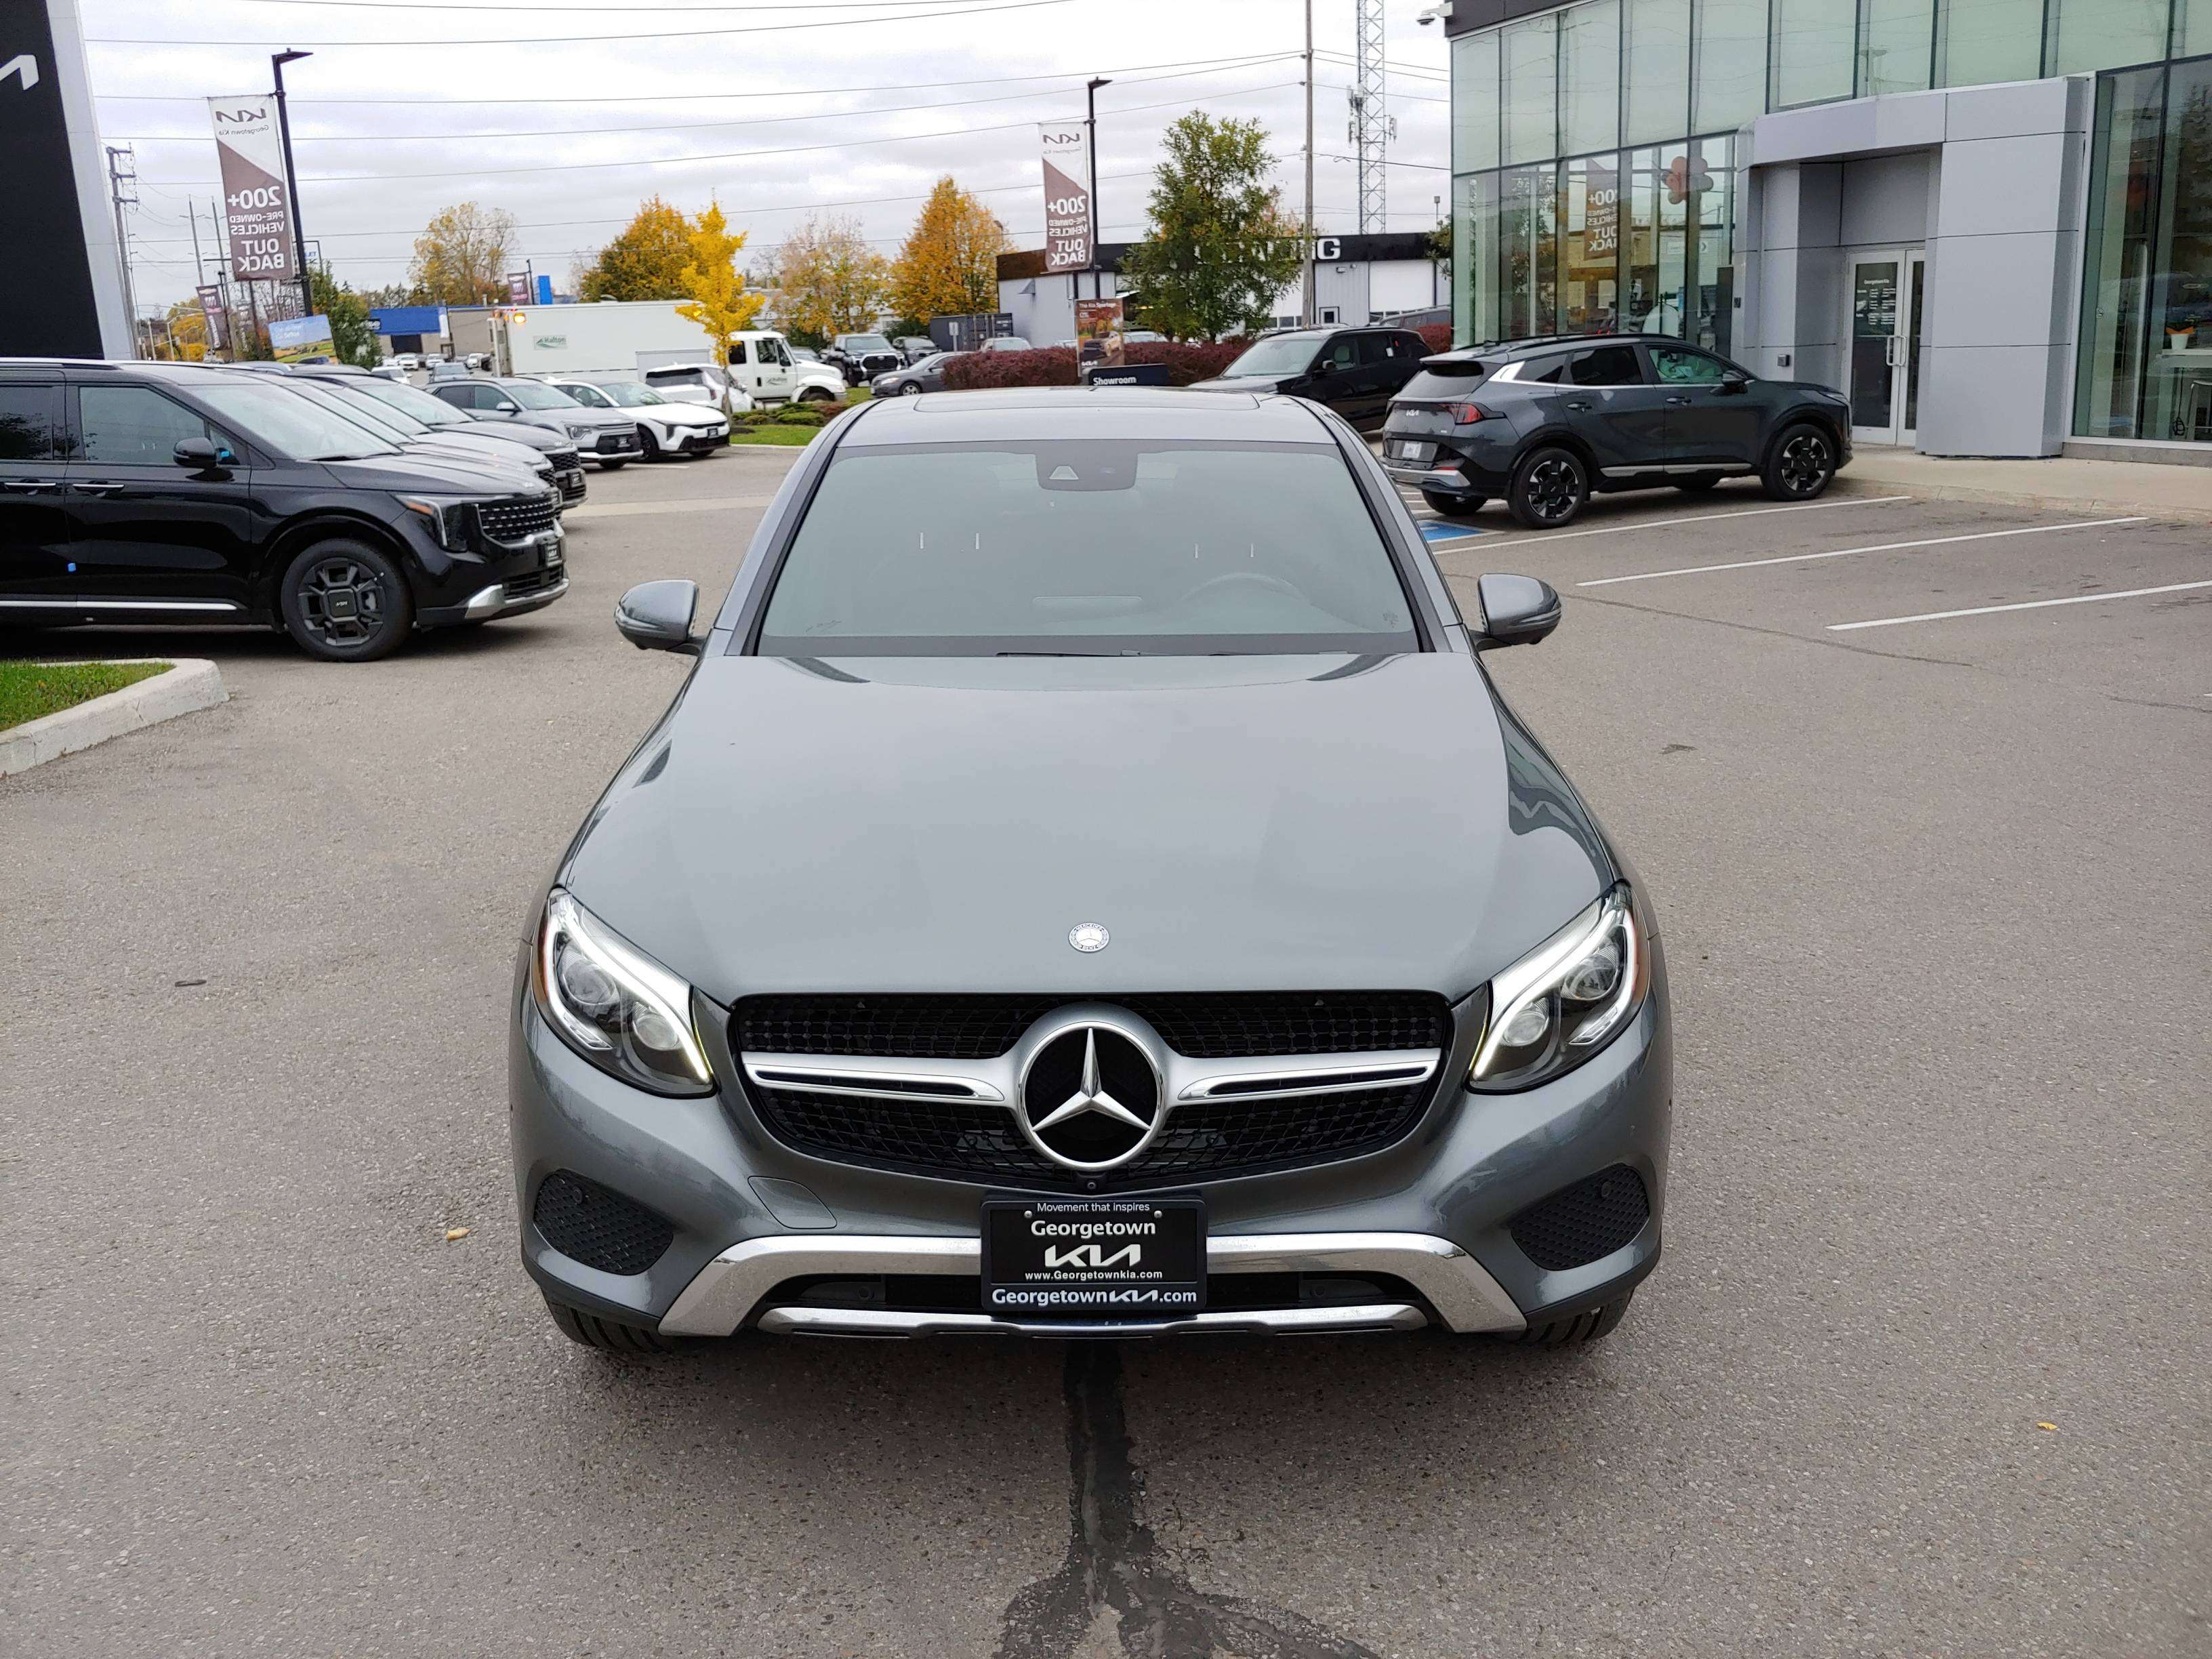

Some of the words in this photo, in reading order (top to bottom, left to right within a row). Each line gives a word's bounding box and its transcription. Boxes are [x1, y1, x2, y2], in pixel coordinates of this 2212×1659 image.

[1092, 376, 1137, 386] Showroom
[1037, 1203, 1088, 1212] Movement
[1091, 1203, 1110, 1212] that
[1113, 1202, 1150, 1213] inspires
[1031, 1221, 1156, 1239] Georgetown
[1044, 1244, 1141, 1267] KIA
[1025, 1270, 1163, 1281] www.Georgetownkia.com
